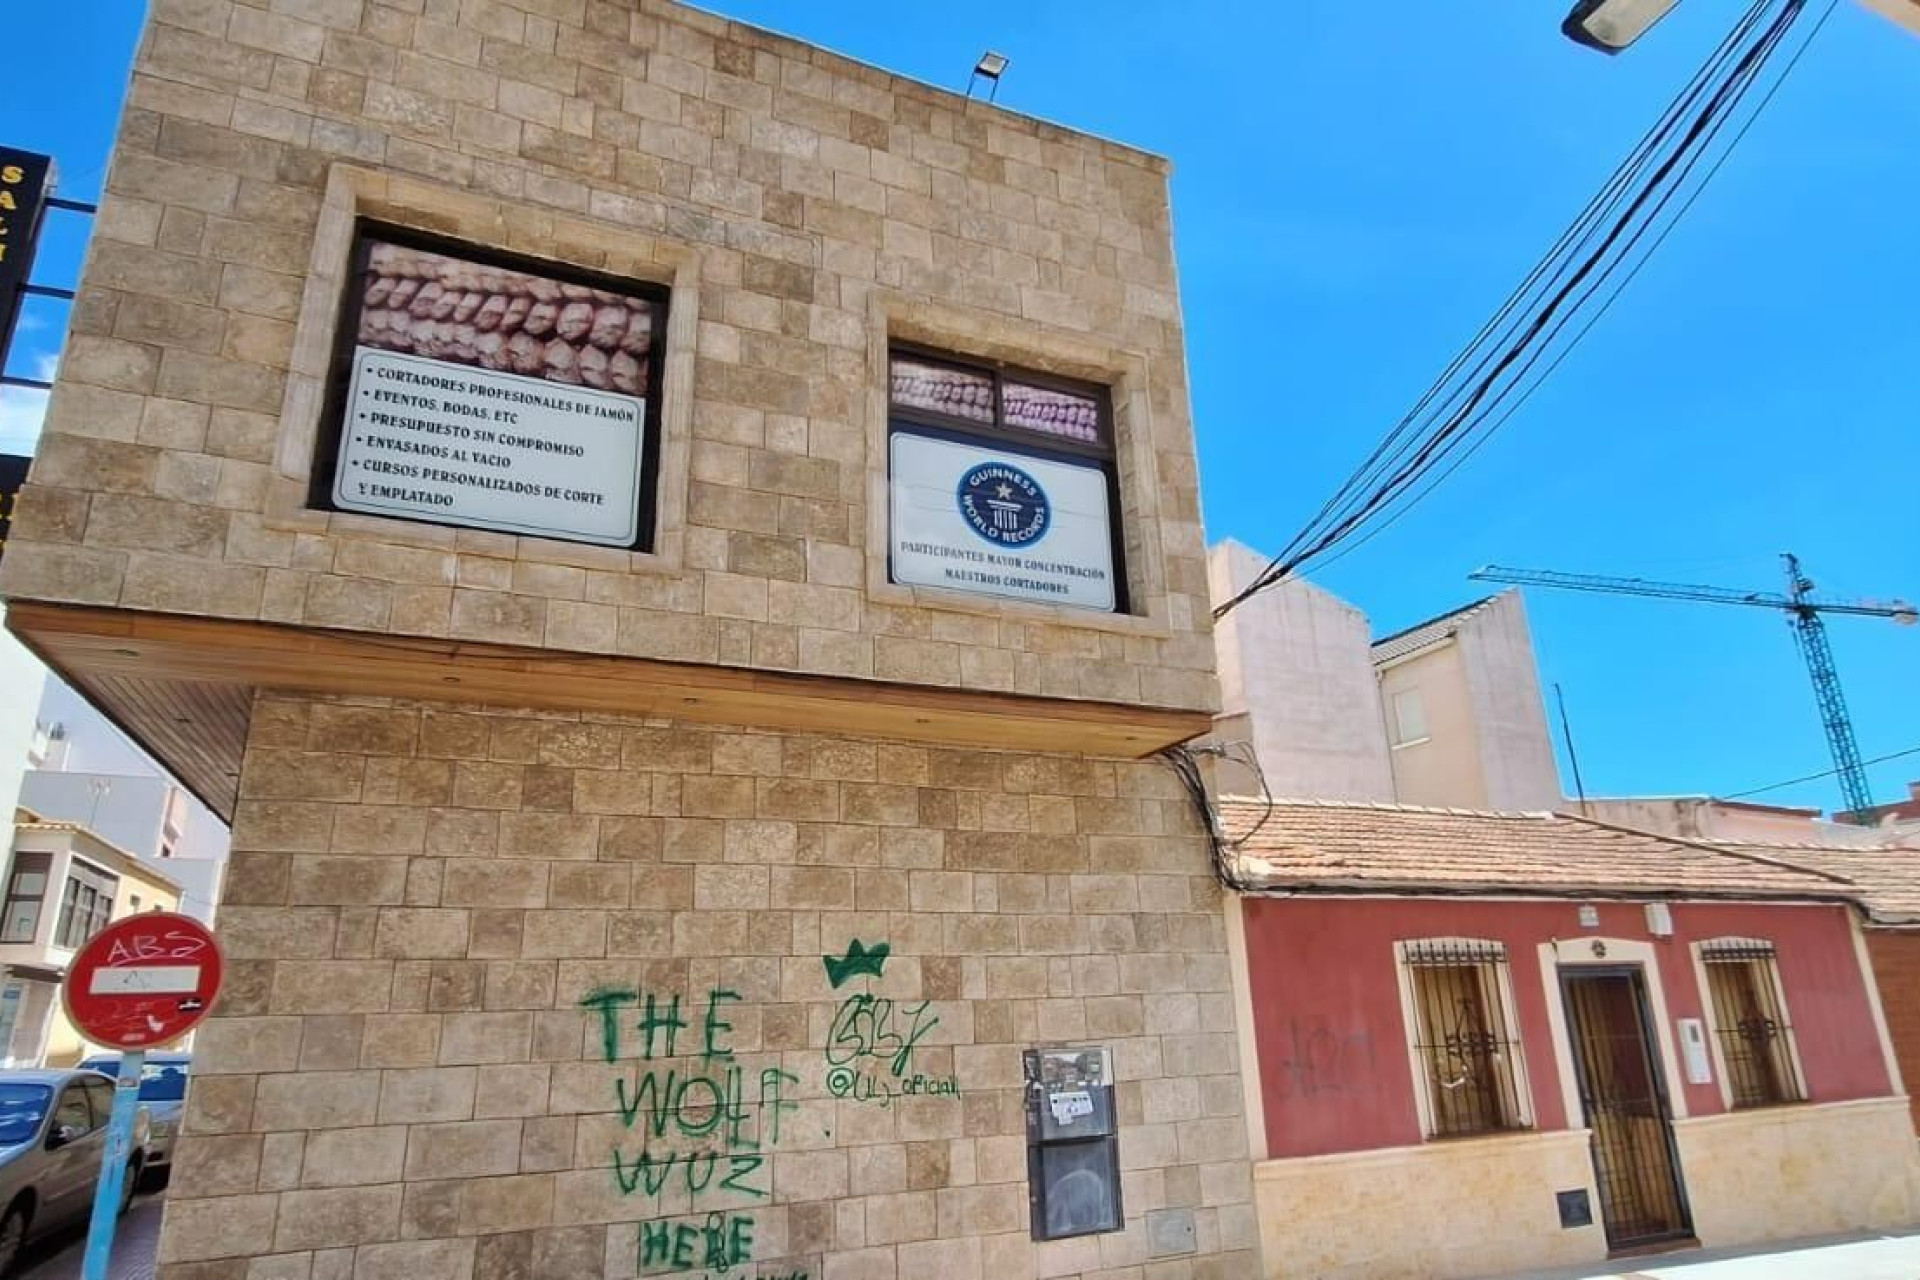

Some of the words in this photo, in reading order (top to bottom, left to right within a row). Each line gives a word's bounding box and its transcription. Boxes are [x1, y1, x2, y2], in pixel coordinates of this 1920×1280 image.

[377, 367, 466, 393] CORTADORES
[469, 383, 572, 413] PROFESIONALES
[575, 402, 592, 416] DE
[370, 411, 470, 439] PRESUPUESTO
[473, 429, 495, 443] SIN
[499, 433, 584, 458] COMPROMISO
[494, 410, 519, 425] ETC
[366, 435, 449, 459] ENVASADOS
[451, 449, 468, 462] AL
[358, 482, 368, 495] Y
[370, 484, 454, 506] EMPLATADO
[363, 459, 419, 477] CURSOS
[422, 467, 541, 496] PERSONALIZADOS
[544, 486, 563, 499] DE
[563, 489, 604, 505] CORTE
[970, 468, 1037, 496] GUINNESS
[963, 494, 998, 538] WORLD
[1002, 506, 1044, 543] RECORDS
[900, 541, 985, 563] PARTICIPANTES
[987, 554, 1022, 569] MAYOR
[945, 568, 1001, 586] MAESTROS
[1003, 577, 1069, 595] CORTADORES
[580, 989, 743, 1064] THE
[614, 1149, 770, 1197] WUZ
[638, 1212, 755, 1272] HERE
